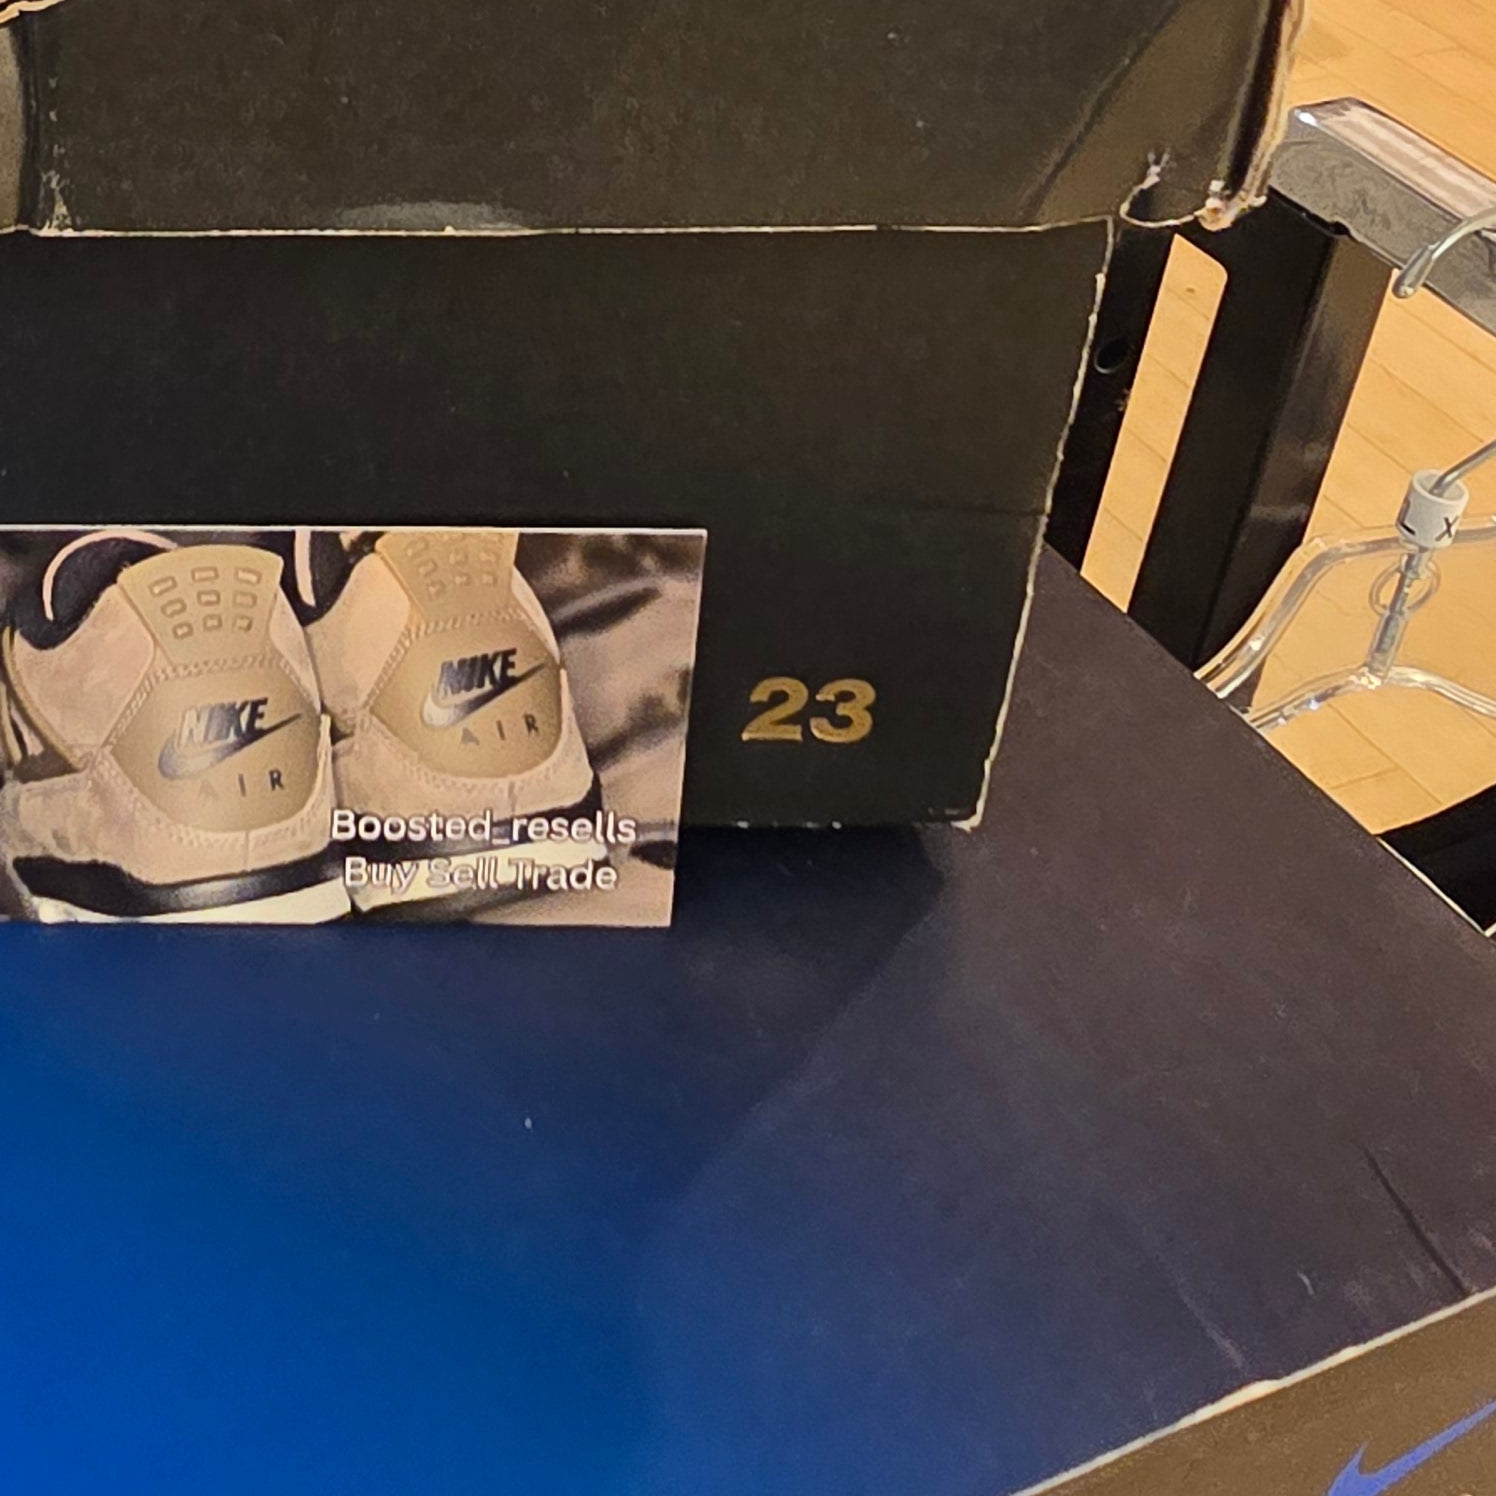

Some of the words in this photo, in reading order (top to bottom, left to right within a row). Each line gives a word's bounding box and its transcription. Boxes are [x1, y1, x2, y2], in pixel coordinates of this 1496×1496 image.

[438, 648, 518, 699] NIKE
[175, 697, 270, 747] NIKE
[741, 676, 877, 743] 23
[459, 713, 541, 747] AIR
[197, 769, 286, 800] AIR
[331, 808, 637, 846] Boosted_resells
[344, 856, 419, 893] Buy
[427, 856, 500, 891] Sell
[507, 858, 619, 891] Trade
